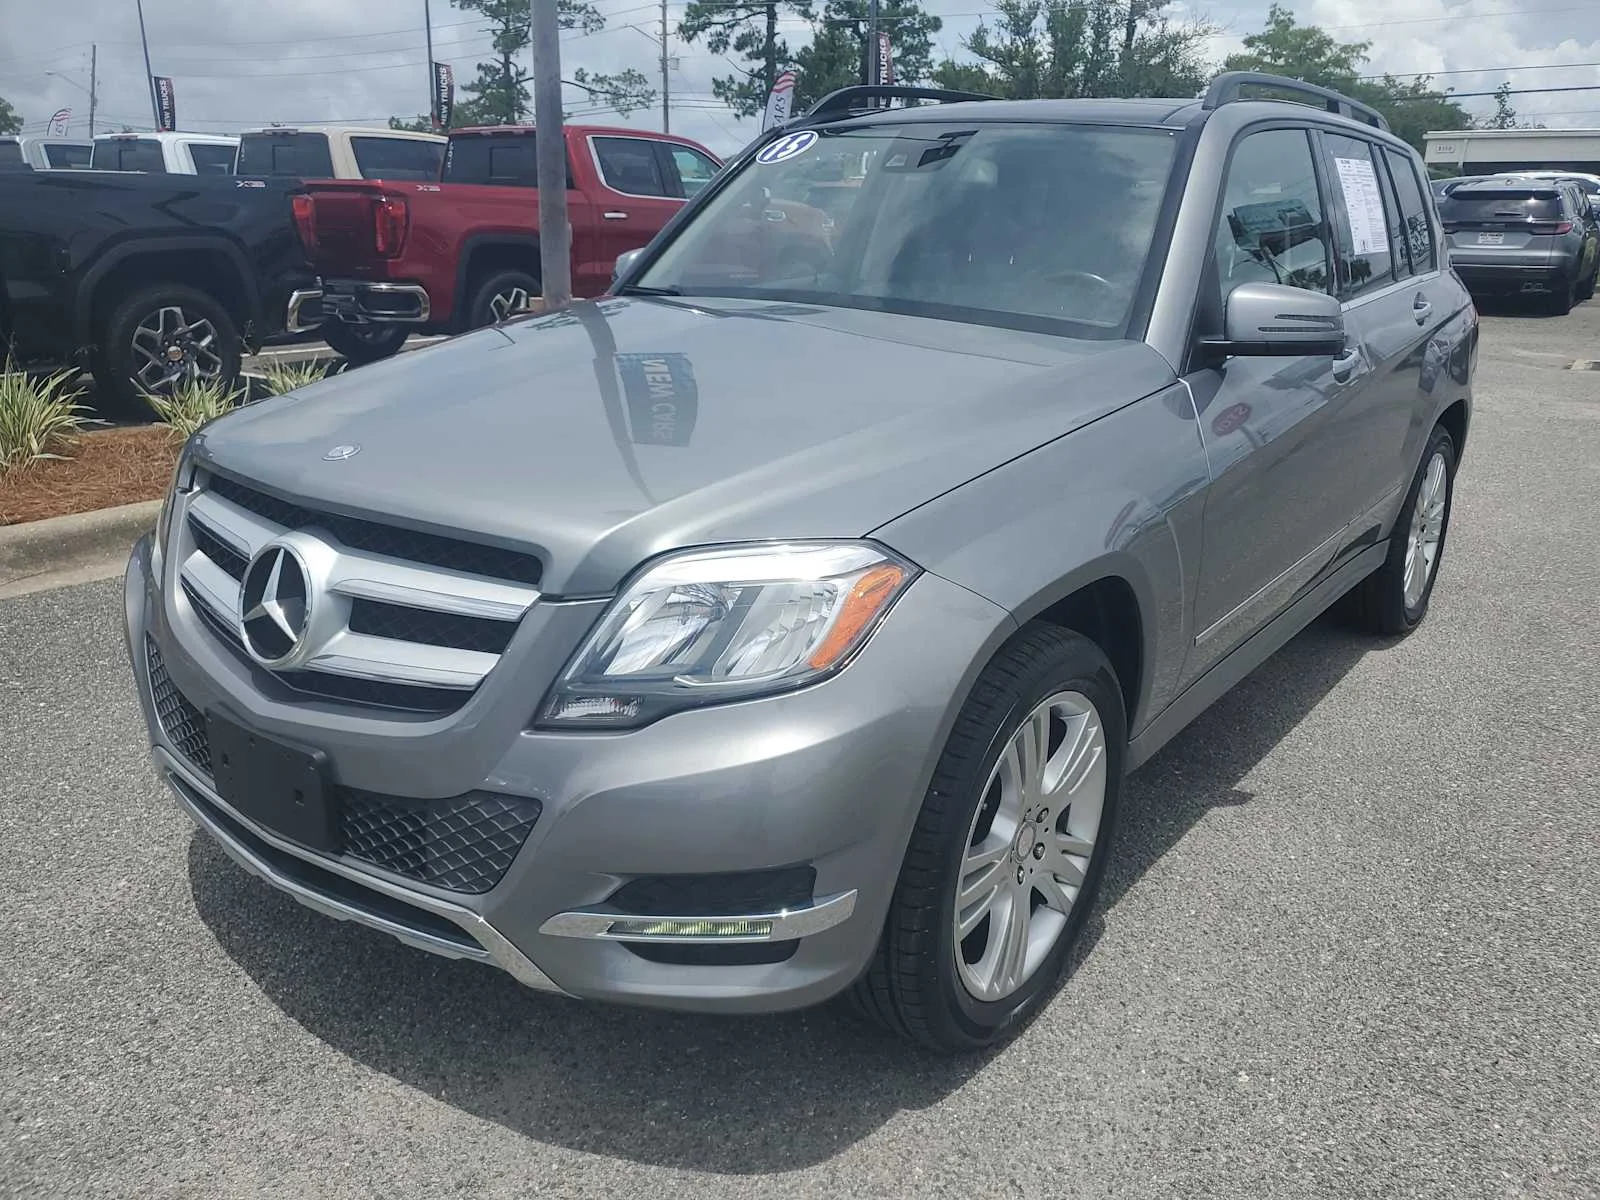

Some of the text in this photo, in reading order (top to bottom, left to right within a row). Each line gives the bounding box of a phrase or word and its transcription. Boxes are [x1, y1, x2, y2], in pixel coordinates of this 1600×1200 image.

[160, 80, 170, 111] TRUCKS
[439, 65, 449, 125] NEW TRUCKS
[772, 96, 786, 128] ARS
